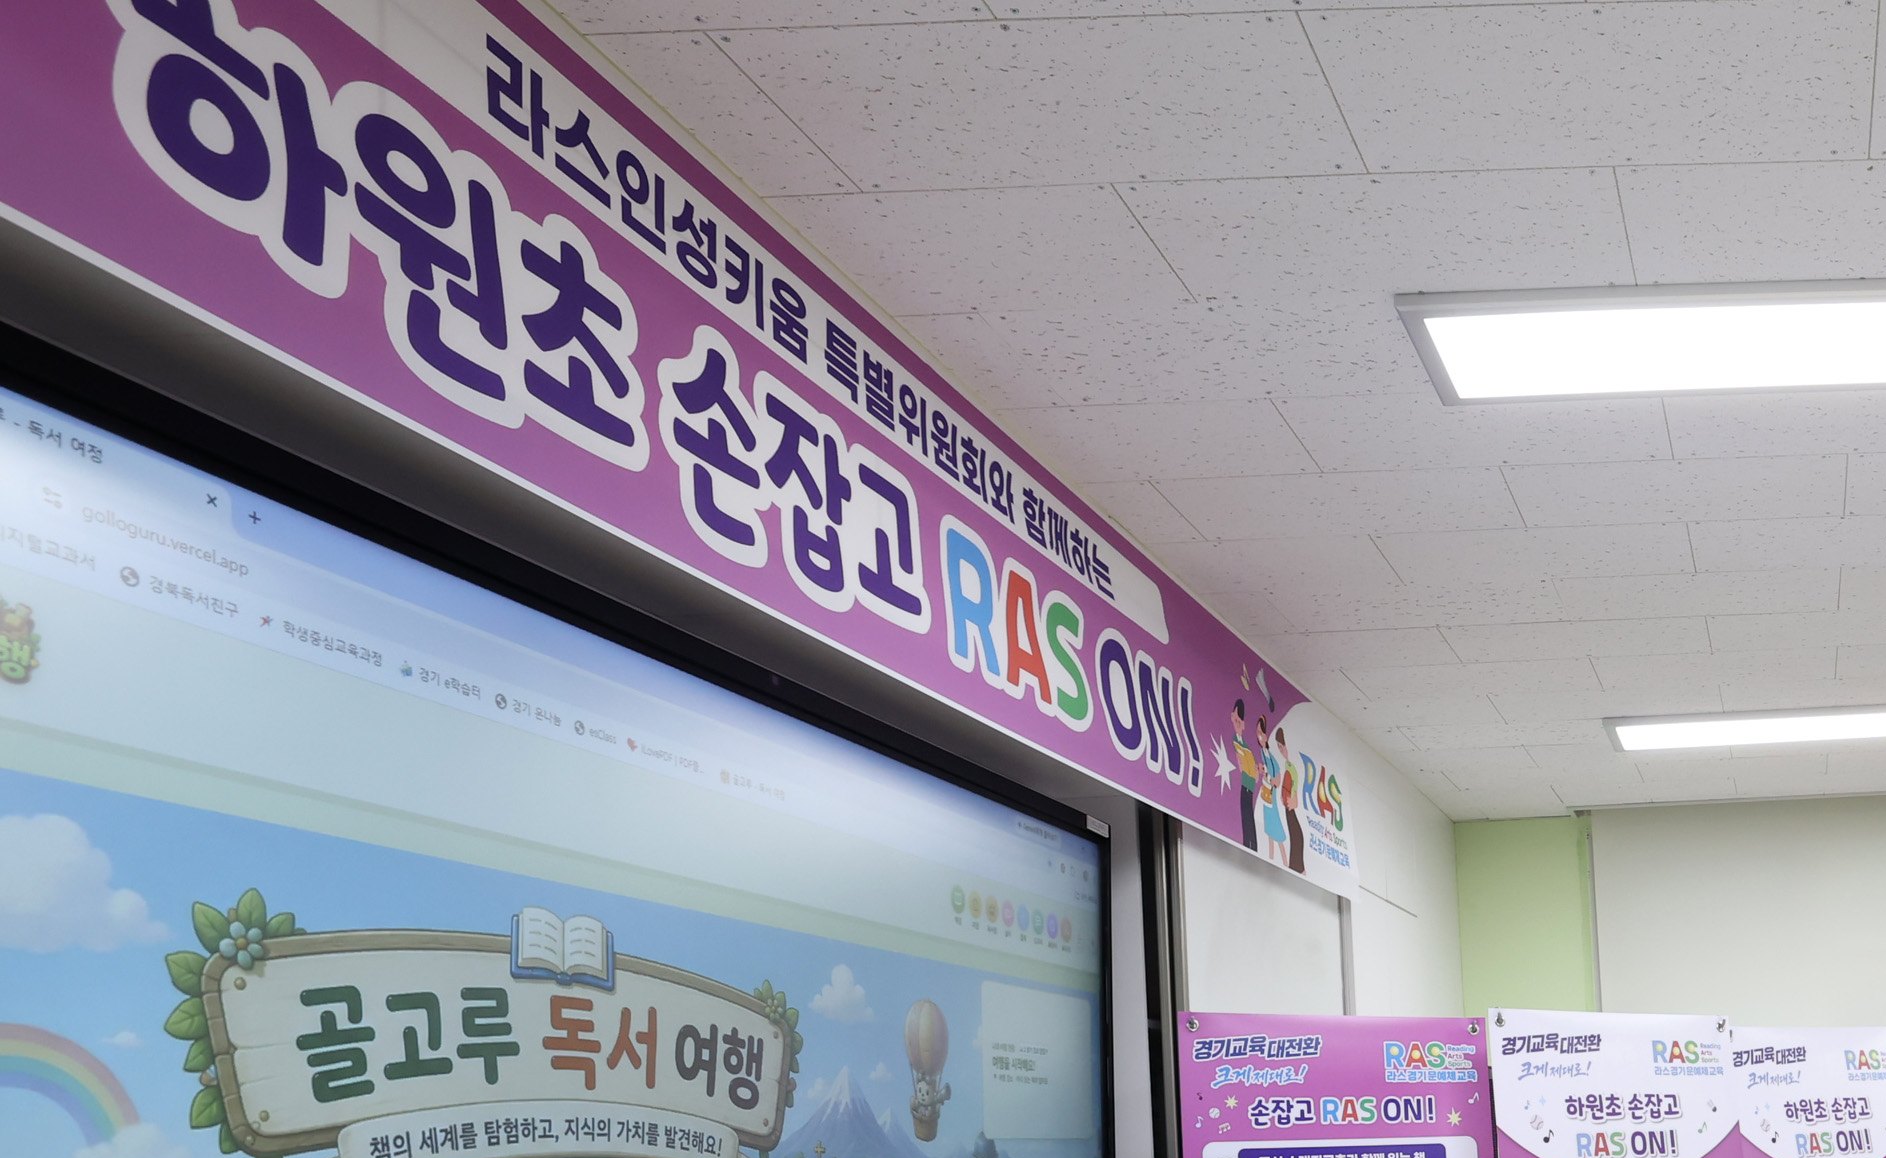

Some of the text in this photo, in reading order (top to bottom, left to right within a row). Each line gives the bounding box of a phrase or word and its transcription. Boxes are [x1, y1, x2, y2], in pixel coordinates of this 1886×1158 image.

[486, 33, 1115, 600] 라스인성키움 특별위원회와 함께하는
[131, 0, 1201, 788] 하원초 손잡고 RAS ON!
[26, 418, 104, 464] 독서 여정
[81, 504, 250, 579] golloguru.vercel.app
[283, 619, 384, 667] 학생중심교육과정
[1299, 751, 1343, 831] RAS
[296, 985, 764, 1109] 골고루 독서 여행
[1384, 1042, 1446, 1068] RAS
[1652, 1040, 1700, 1063] RAS
[1844, 1049, 1881, 1071] RAS
[1250, 1097, 1435, 1126] 손잡고 RAS ON!
[1565, 1094, 1679, 1120] 하원초 손잡고
[1784, 1097, 1870, 1122] 하원초 손잡고
[419, 1122, 478, 1155] 세계를
[483, 1117, 560, 1149] 탐험하고,
[564, 1118, 613, 1144] 지식의
[616, 1119, 660, 1148] 가치를
[664, 1127, 722, 1157] 발견해요!
[1576, 1129, 1677, 1157] RAS ON!
[1795, 1129, 1871, 1155] RAS ON!
